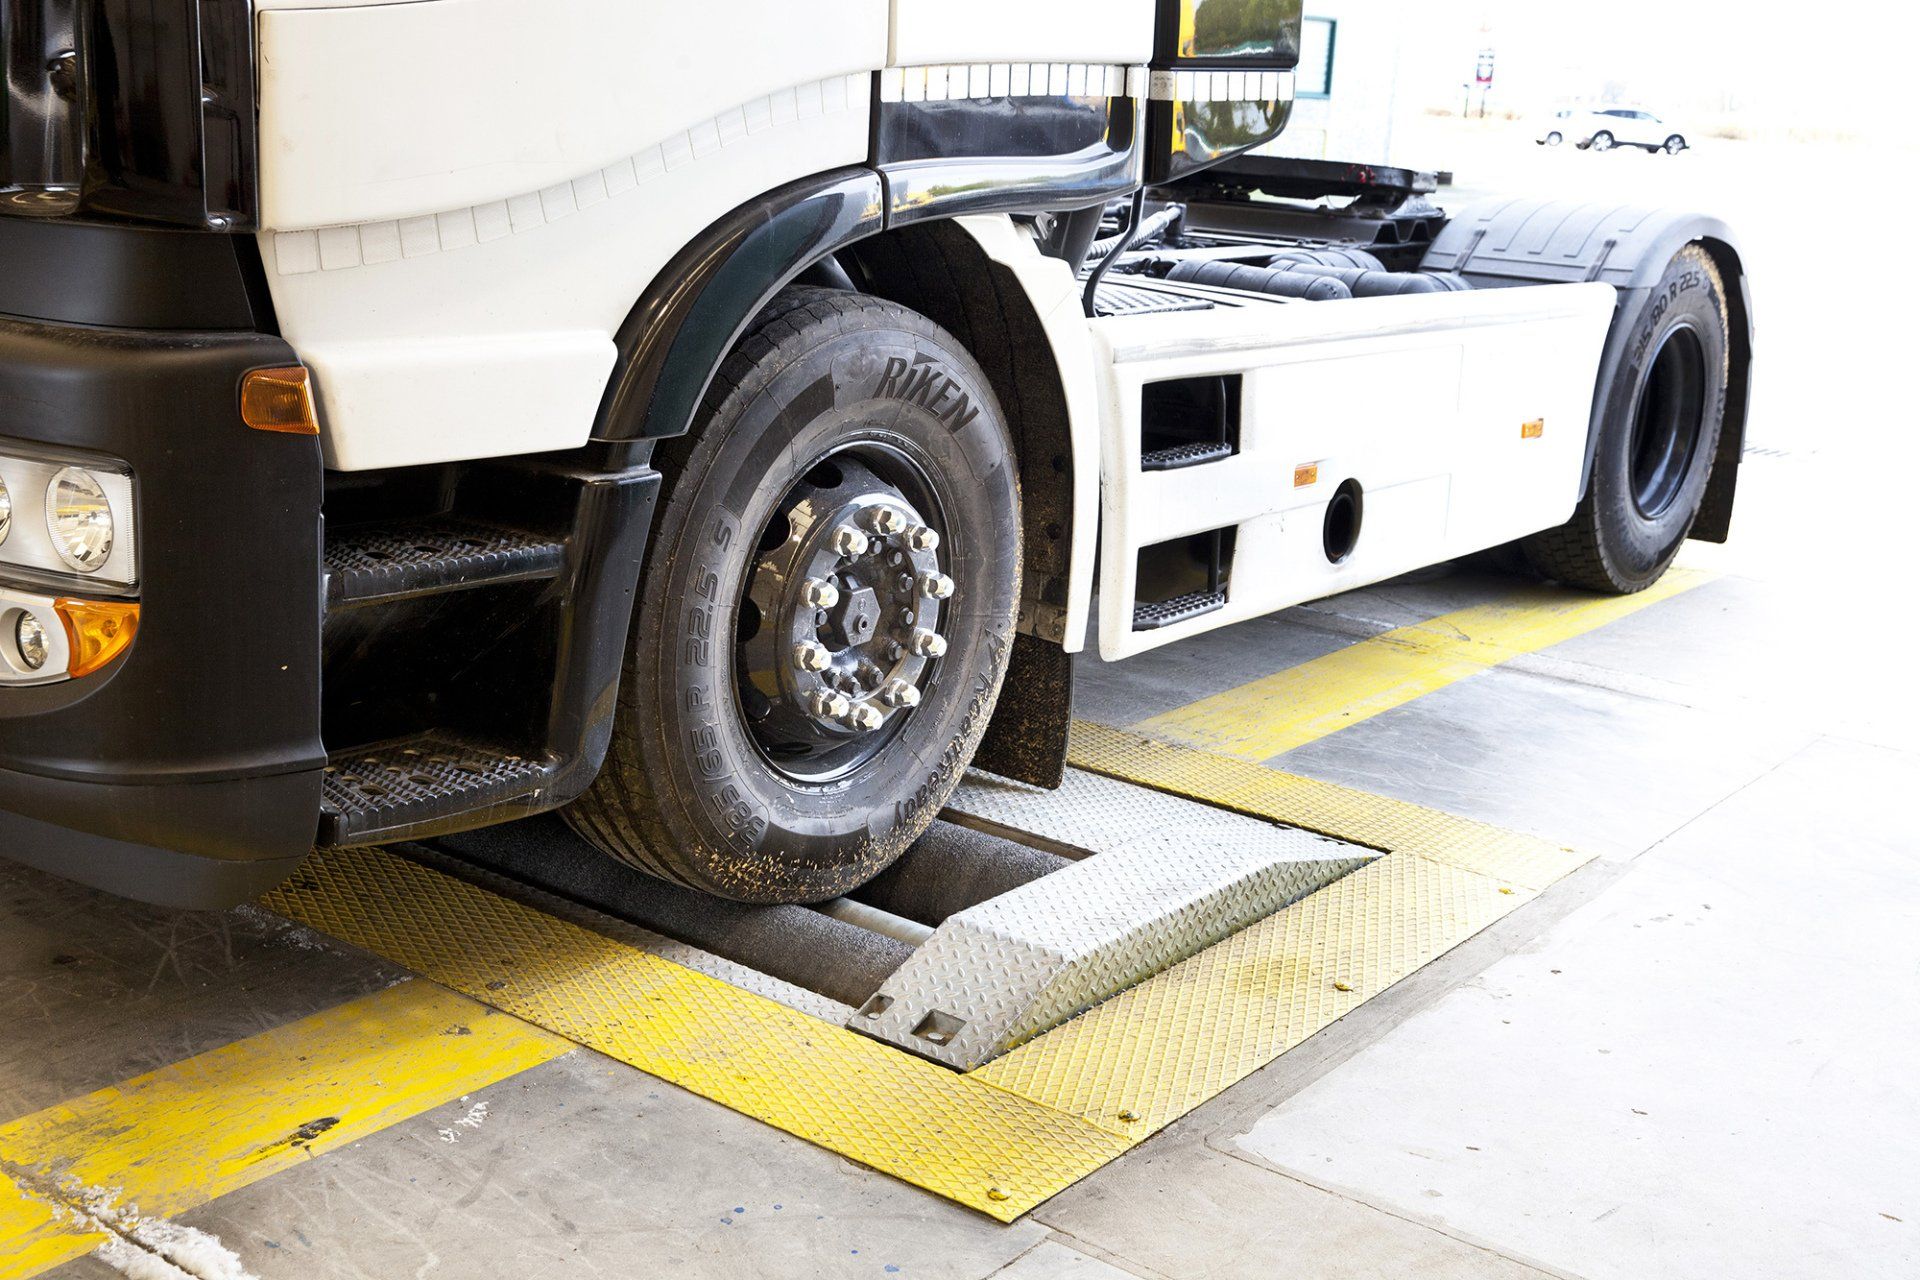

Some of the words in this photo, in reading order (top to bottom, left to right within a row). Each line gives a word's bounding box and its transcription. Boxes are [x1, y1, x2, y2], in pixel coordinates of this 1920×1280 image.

[1668, 282, 1677, 302] R
[871, 350, 980, 435] RIKEN
[712, 518, 733, 553] S
[685, 564, 720, 667] 22.5
[686, 685, 710, 713] R
[690, 724, 767, 846] 385/65
